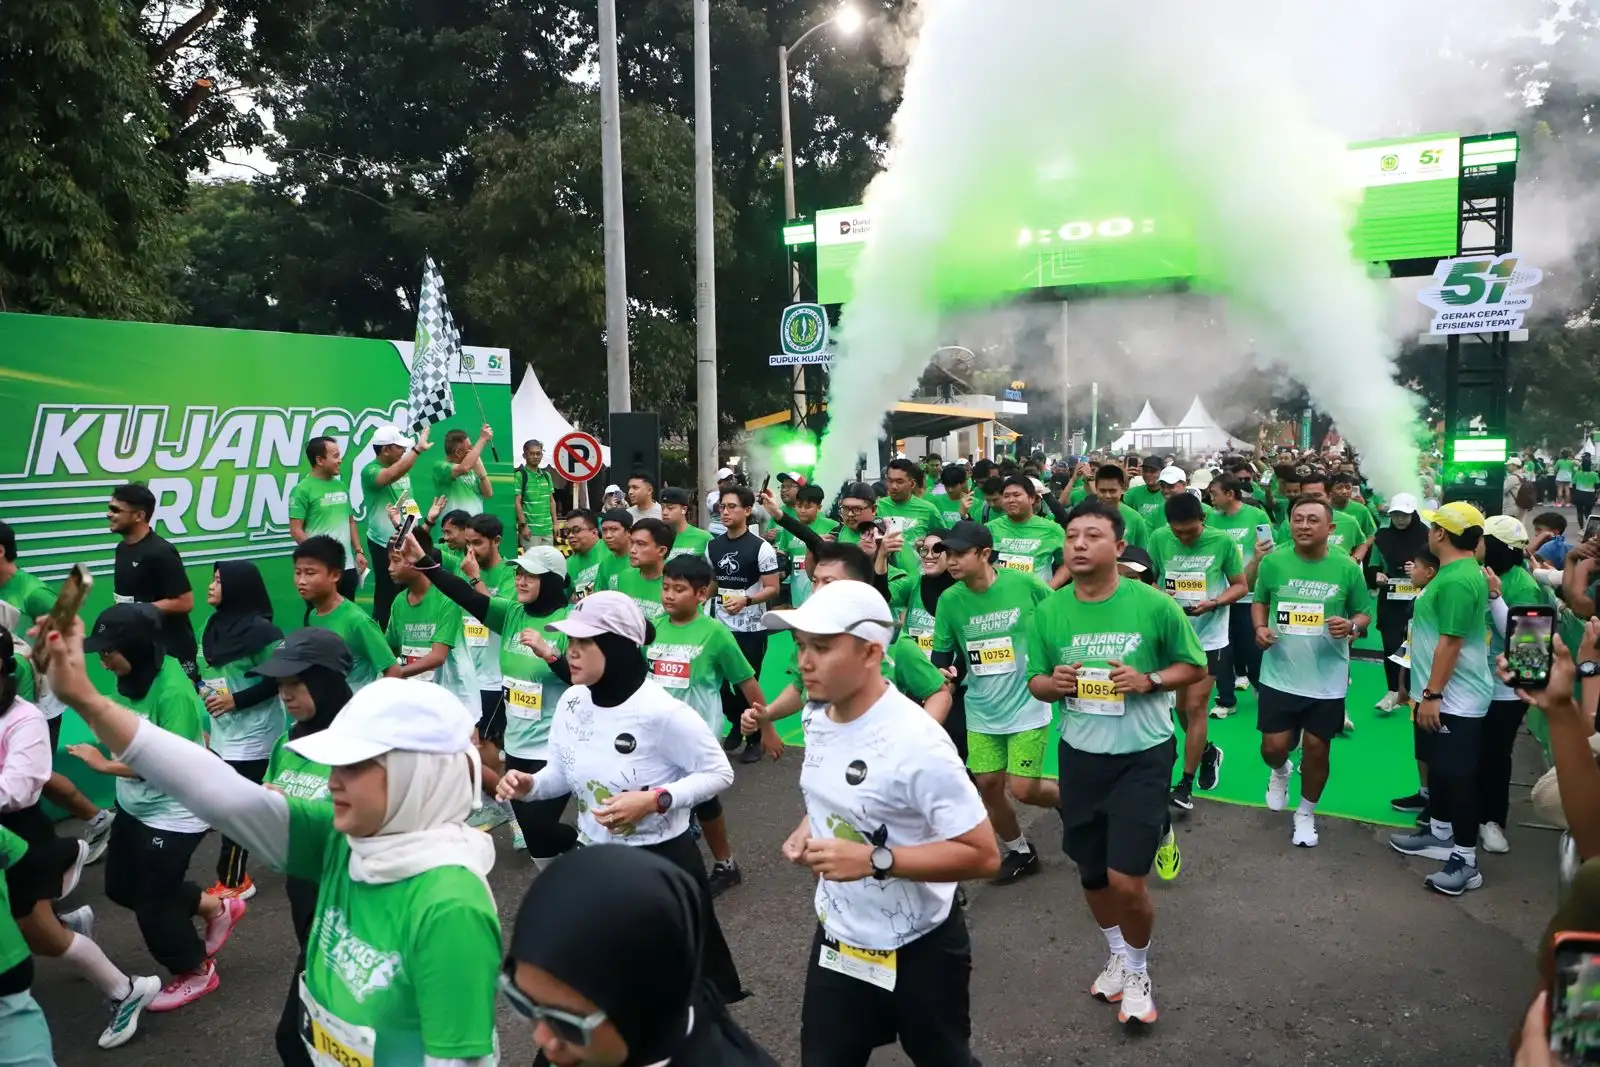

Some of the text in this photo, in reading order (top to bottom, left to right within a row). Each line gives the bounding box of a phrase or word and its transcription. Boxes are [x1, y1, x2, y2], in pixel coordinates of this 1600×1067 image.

[1440, 258, 1518, 306] 51
[1504, 298, 1527, 306] TAHUN
[1441, 309, 1511, 321] GERAK CEPAT
[1436, 318, 1518, 331] EFISIENSI TEPAT
[770, 355, 800, 364] PUPUK
[35, 411, 351, 476] KUJANG
[567, 444, 590, 473] P
[148, 472, 300, 535] RUN
[1008, 560, 1030, 572] 10389
[1166, 580, 1203, 589] M 10996
[1288, 578, 1328, 591] KUJANG
[1298, 587, 1321, 598] RUN
[969, 610, 1009, 626] KUJANG
[1279, 611, 1320, 623] M 11247
[980, 621, 1001, 632] RUN
[1071, 633, 1125, 647] KUJANG
[971, 649, 1011, 662] M 10752
[1087, 645, 1115, 656] RUN
[660, 662, 684, 674] 3057
[1081, 683, 1118, 696] 10954
[513, 692, 537, 705] 11423
